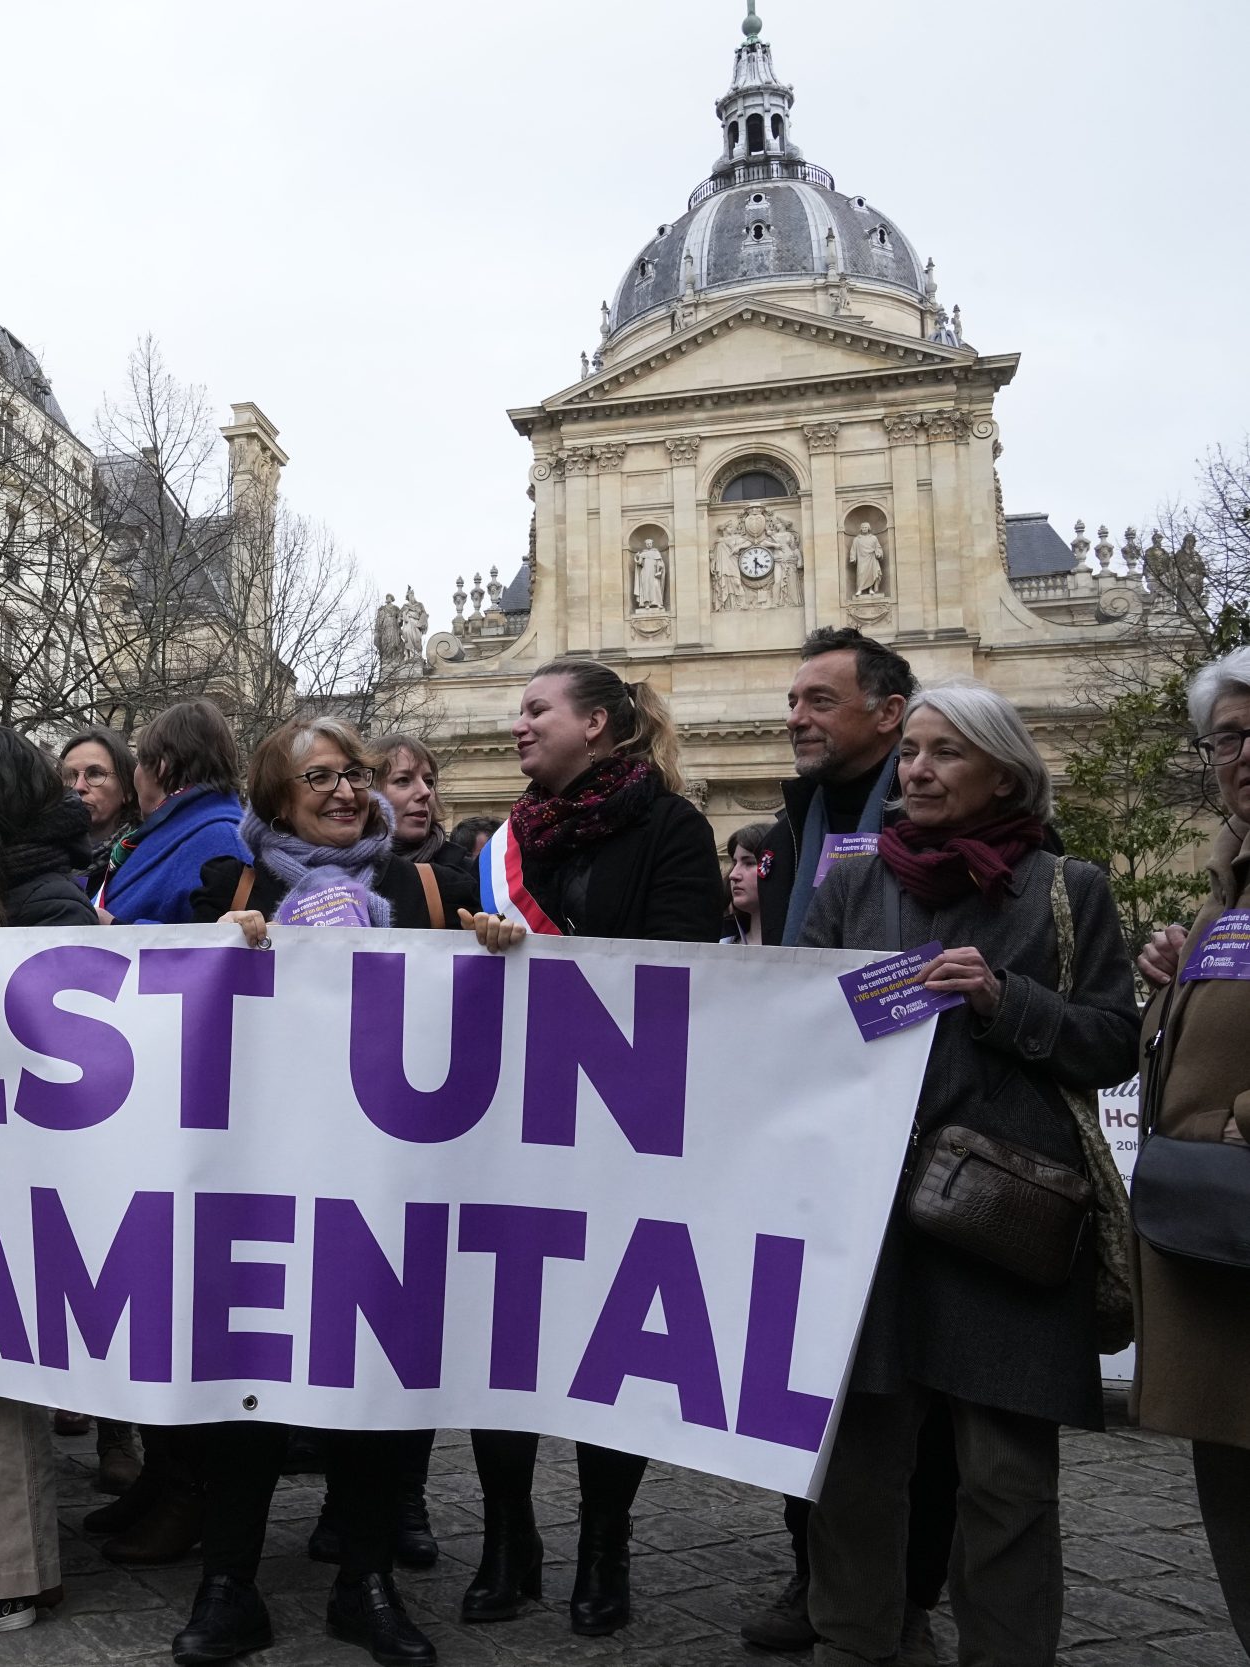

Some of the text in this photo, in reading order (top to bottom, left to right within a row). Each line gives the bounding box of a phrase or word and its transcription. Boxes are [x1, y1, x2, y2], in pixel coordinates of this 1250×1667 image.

[861, 954, 922, 980] Réouverture de tous
[868, 975, 892, 988] centres
[879, 991, 903, 1006] gratuit,
[350, 952, 690, 1158] UN
[1105, 1108, 1139, 1128] Ho
